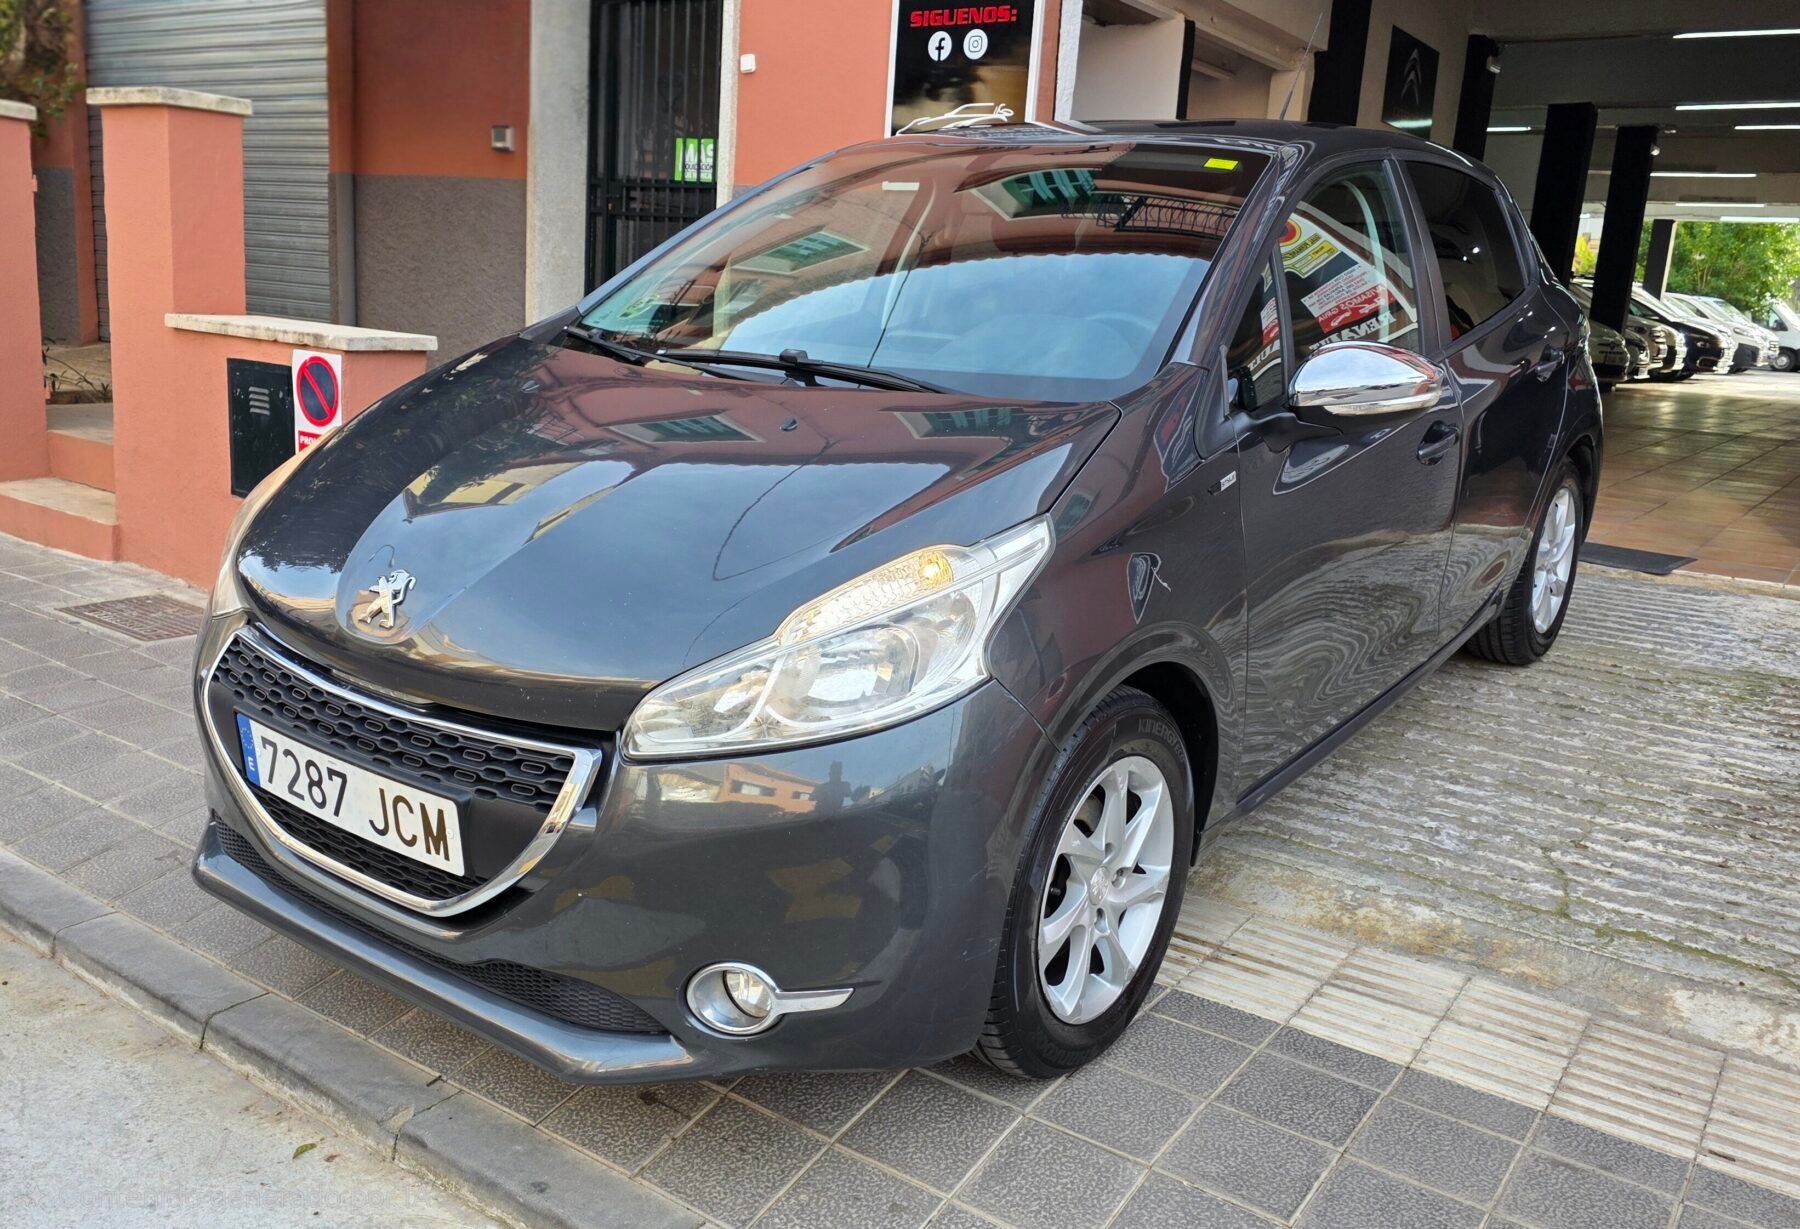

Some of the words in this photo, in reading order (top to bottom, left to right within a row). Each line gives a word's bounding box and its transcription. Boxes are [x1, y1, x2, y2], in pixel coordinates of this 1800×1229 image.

[910, 5, 1018, 27] SIGUENOS:
[247, 756, 256, 772] E
[260, 735, 348, 818] 7287
[368, 787, 450, 862] JCM
